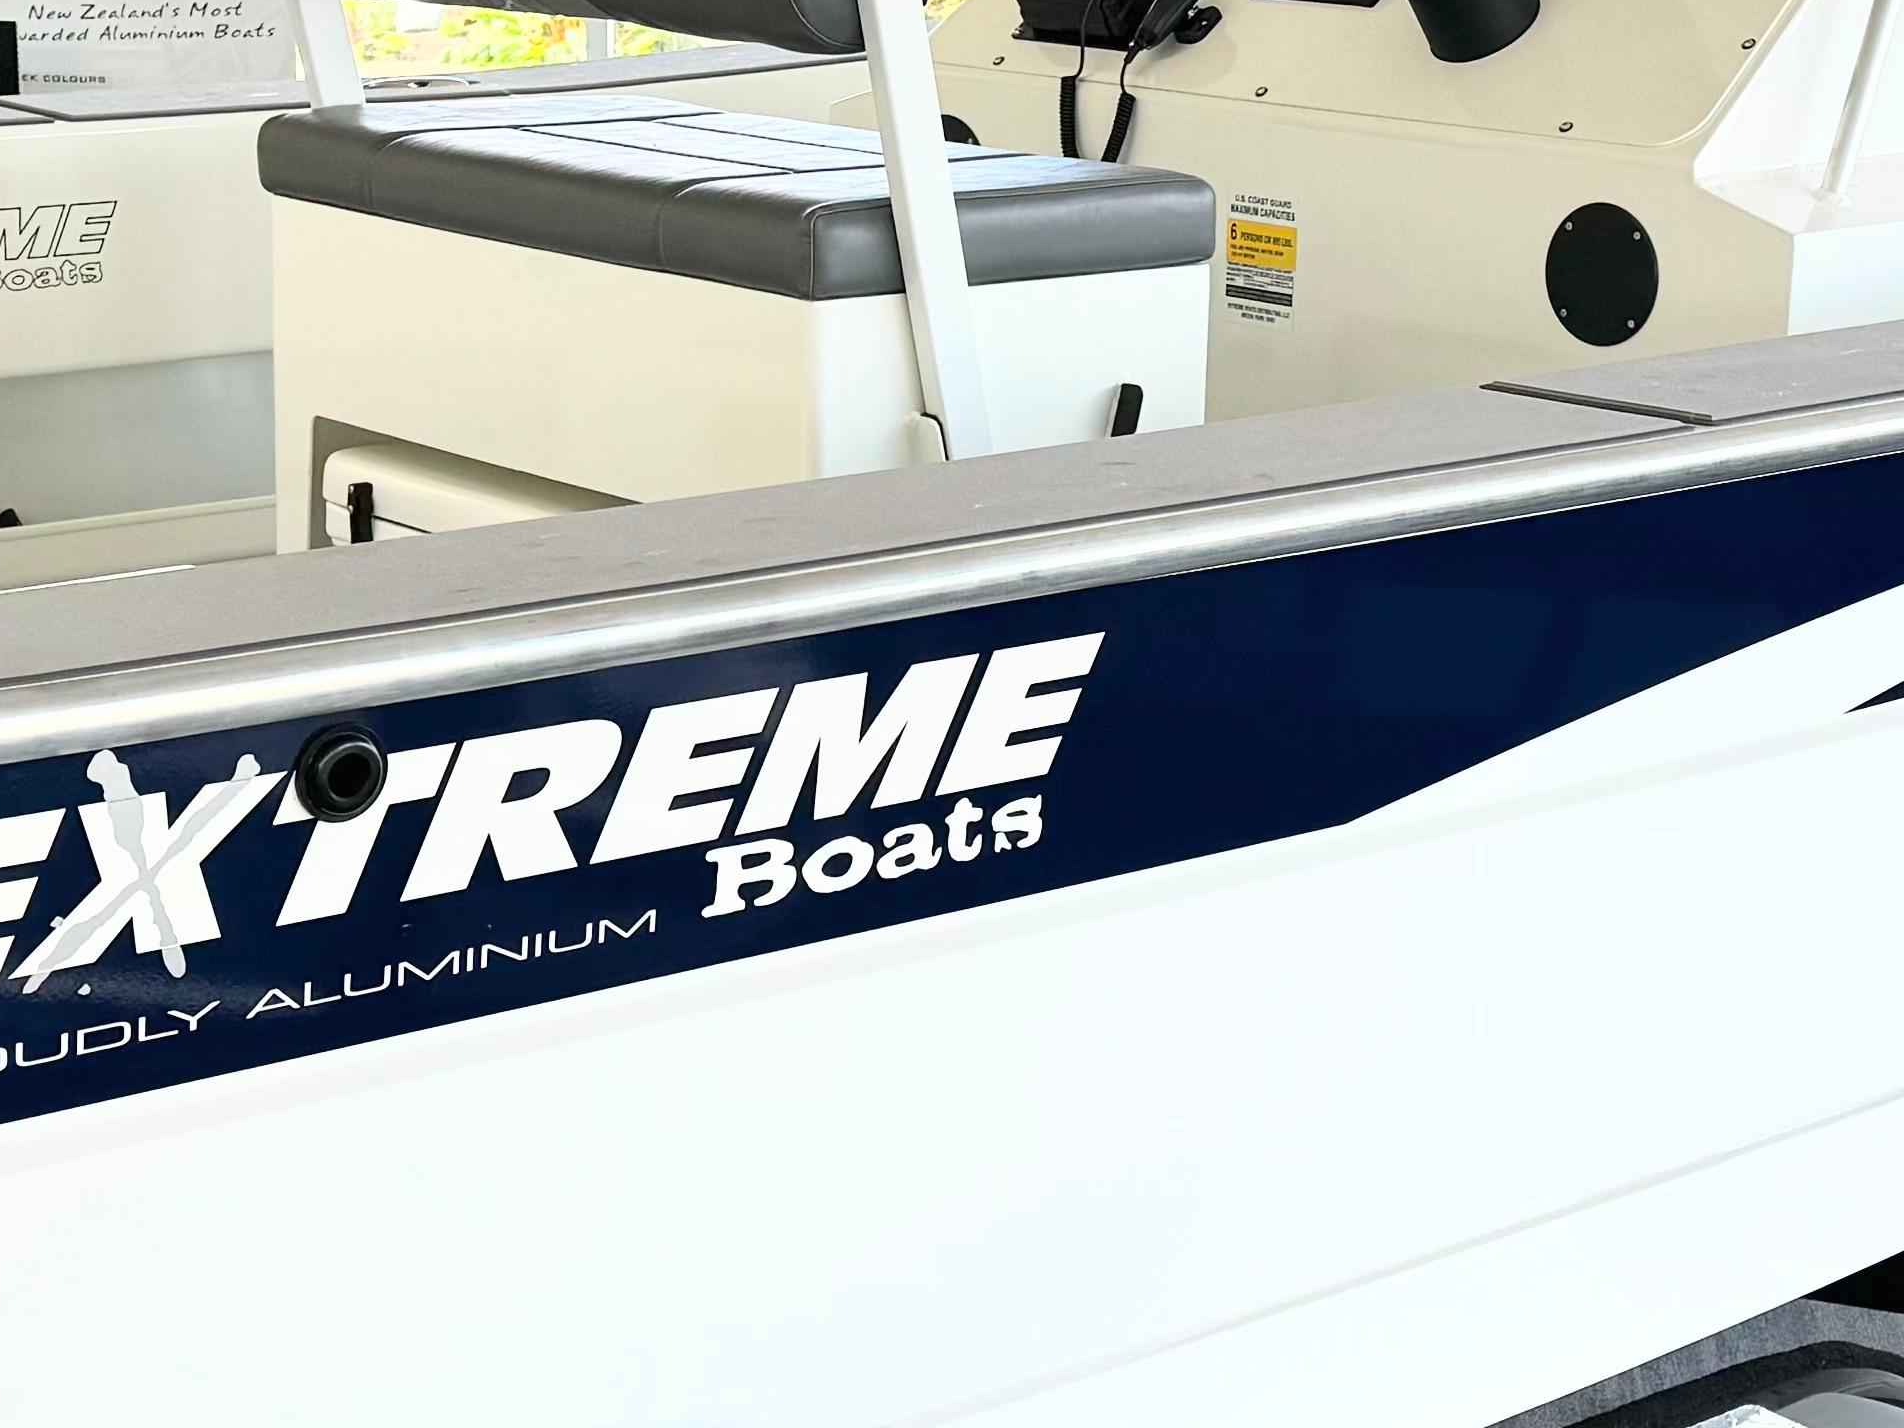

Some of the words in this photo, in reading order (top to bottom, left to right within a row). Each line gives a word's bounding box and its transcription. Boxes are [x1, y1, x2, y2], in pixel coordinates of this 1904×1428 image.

[28, 4, 72, 21] New
[80, 2, 180, 21] Zealand's
[189, 0, 244, 18] Most
[99, 24, 205, 41] Aluminium
[213, 22, 277, 40] Boats
[21, 74, 38, 83] CK
[43, 74, 107, 84] COLOURS
[1230, 222, 1238, 240] 6
[700, 790, 1046, 921] Boats
[245, 908, 659, 1021] ALUMINIUM
